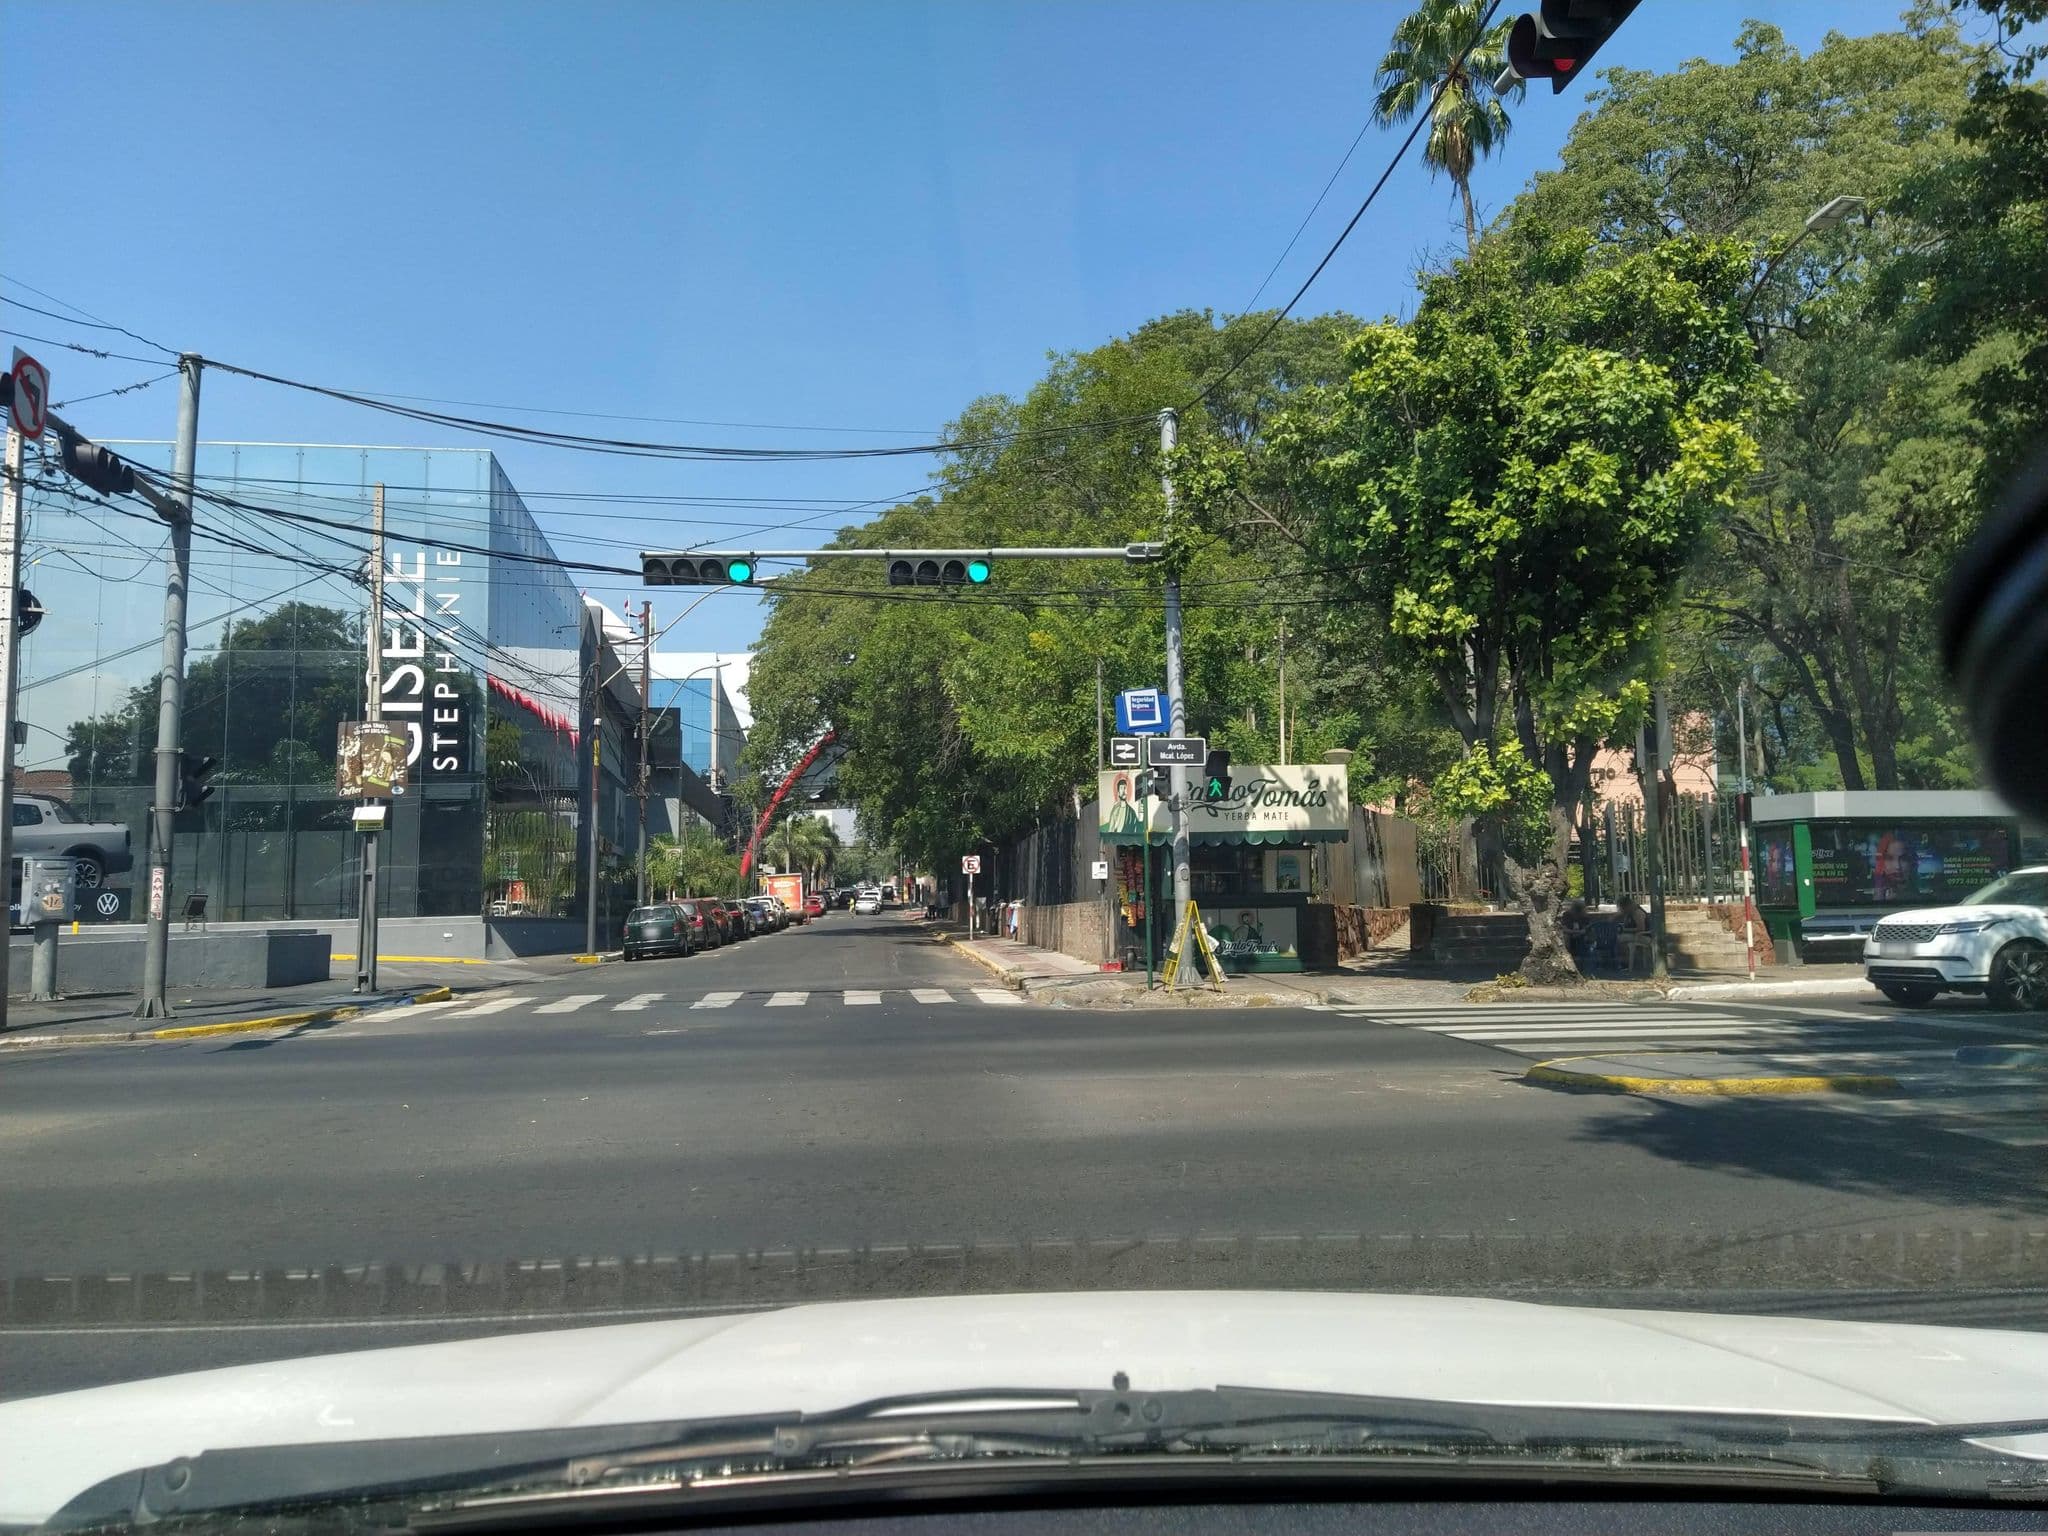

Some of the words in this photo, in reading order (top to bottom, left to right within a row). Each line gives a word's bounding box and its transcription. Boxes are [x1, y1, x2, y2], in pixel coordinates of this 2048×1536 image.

[433, 551, 461, 771] STEPHANIE
[1167, 743, 1187, 751] Avda.
[1176, 751, 1195, 761] López
[1246, 778, 1328, 809] Tomás
[1224, 811, 1257, 821] YERBA
[1263, 811, 1290, 821] MATE
